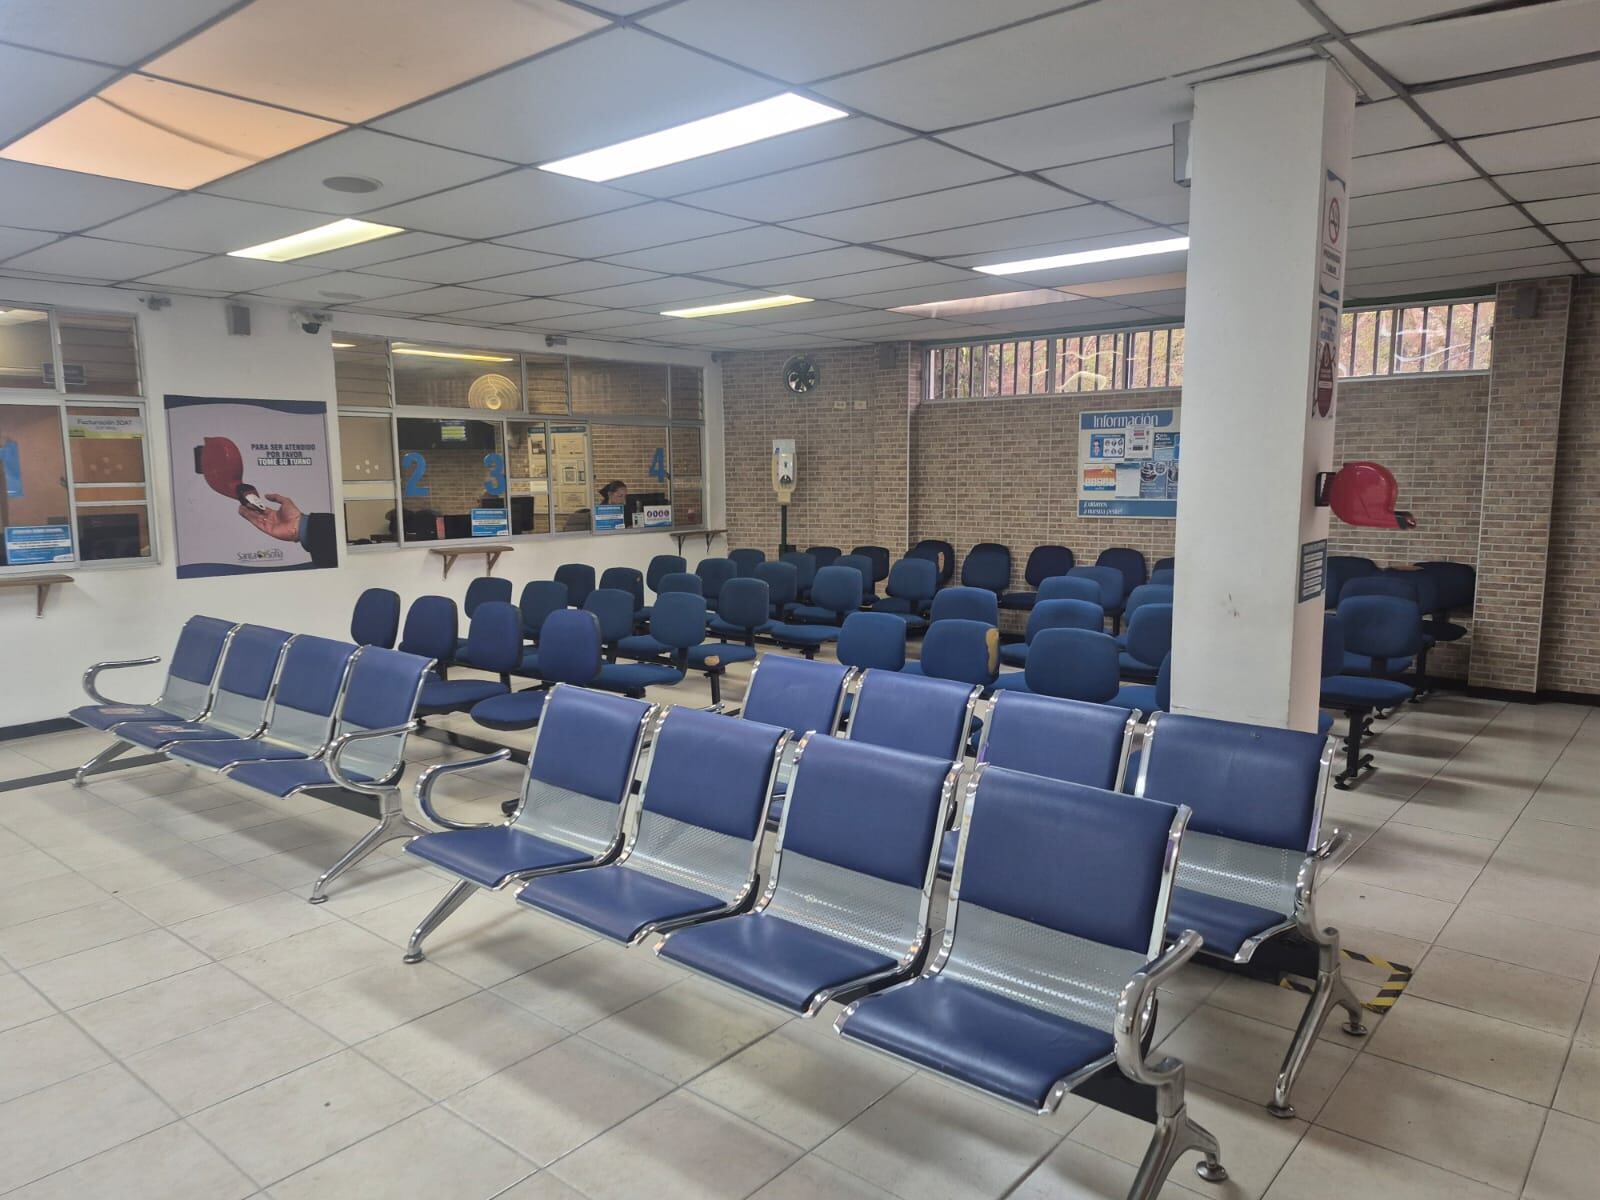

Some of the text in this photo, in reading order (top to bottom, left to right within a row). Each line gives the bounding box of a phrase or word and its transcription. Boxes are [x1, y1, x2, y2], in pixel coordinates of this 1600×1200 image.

[1093, 412, 1159, 428] Información
[251, 443, 316, 451] PARA SER ATENDIDO
[258, 458, 311, 466] TOME SU TURNO
[648, 447, 666, 483] 4
[402, 452, 430, 496] 2
[483, 452, 506, 496] 3
[236, 551, 259, 561] Santa
